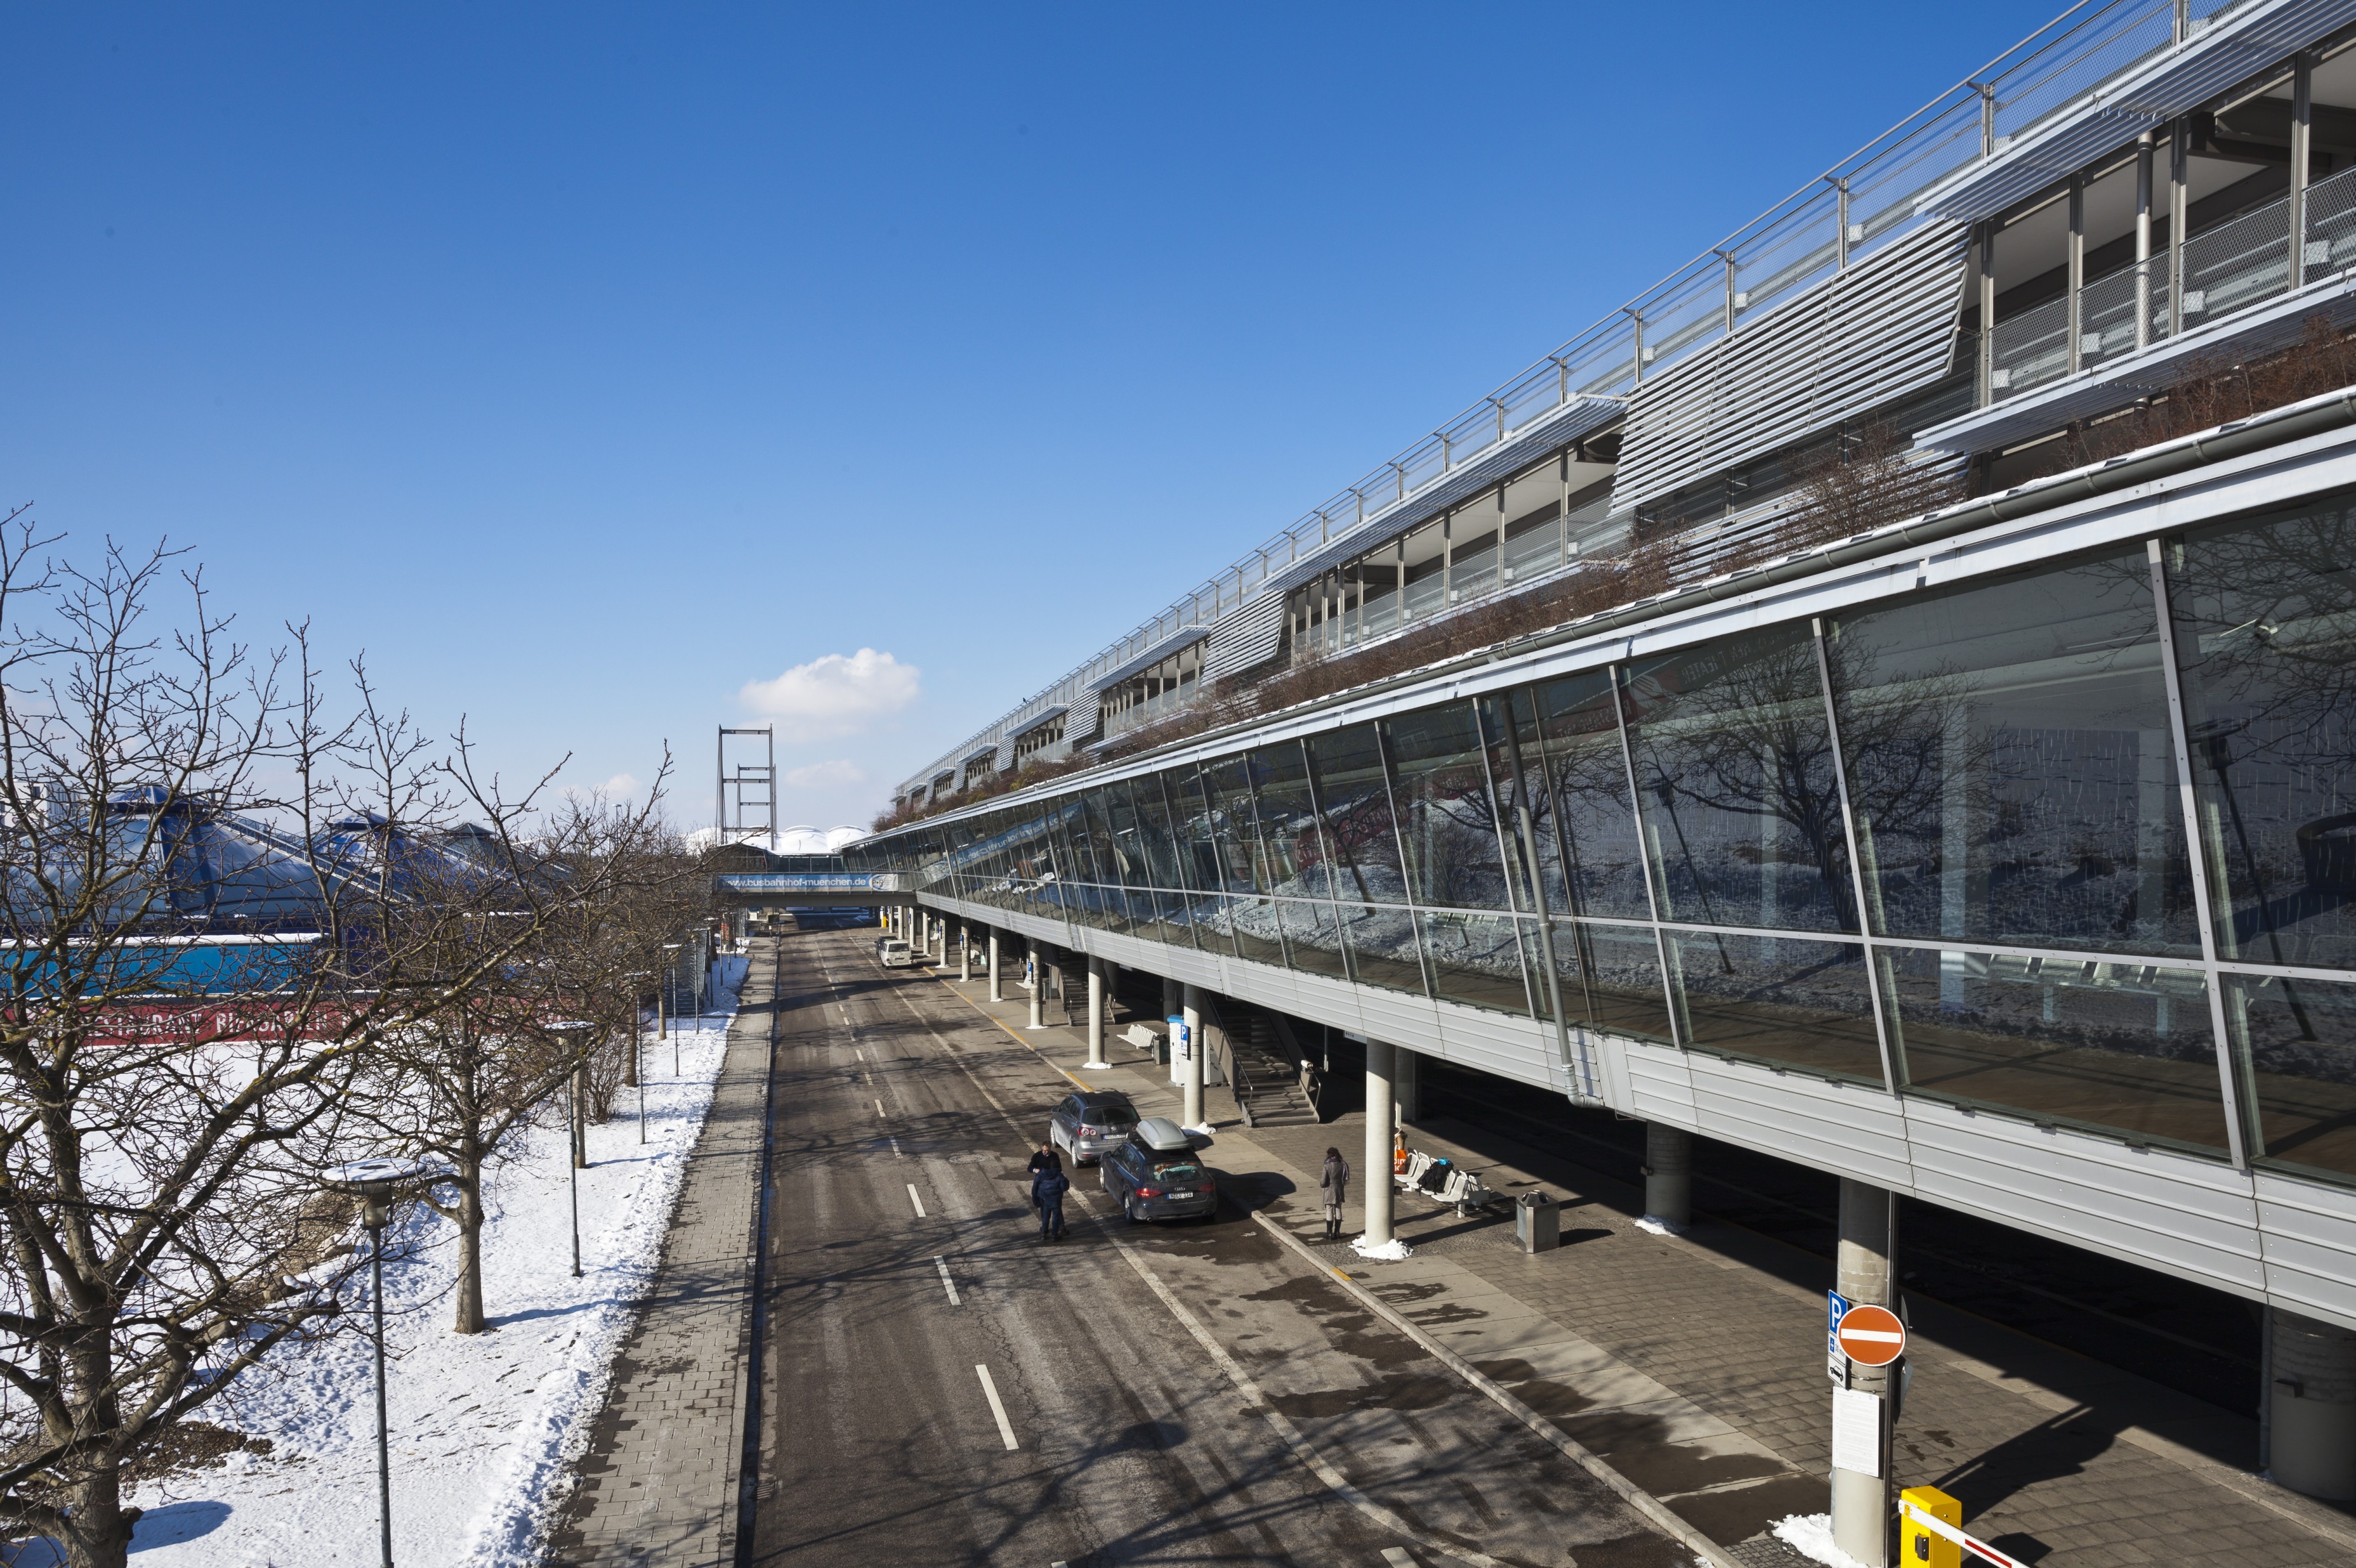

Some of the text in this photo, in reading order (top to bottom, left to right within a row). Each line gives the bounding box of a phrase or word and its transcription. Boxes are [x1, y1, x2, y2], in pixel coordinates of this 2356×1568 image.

[723, 878, 866, 886] www.busbahnhof-muenchen.de
[216, 1010, 327, 1033] BIEGAREN
[1182, 1026, 1186, 1038] P
[1832, 1297, 1842, 1328] P
